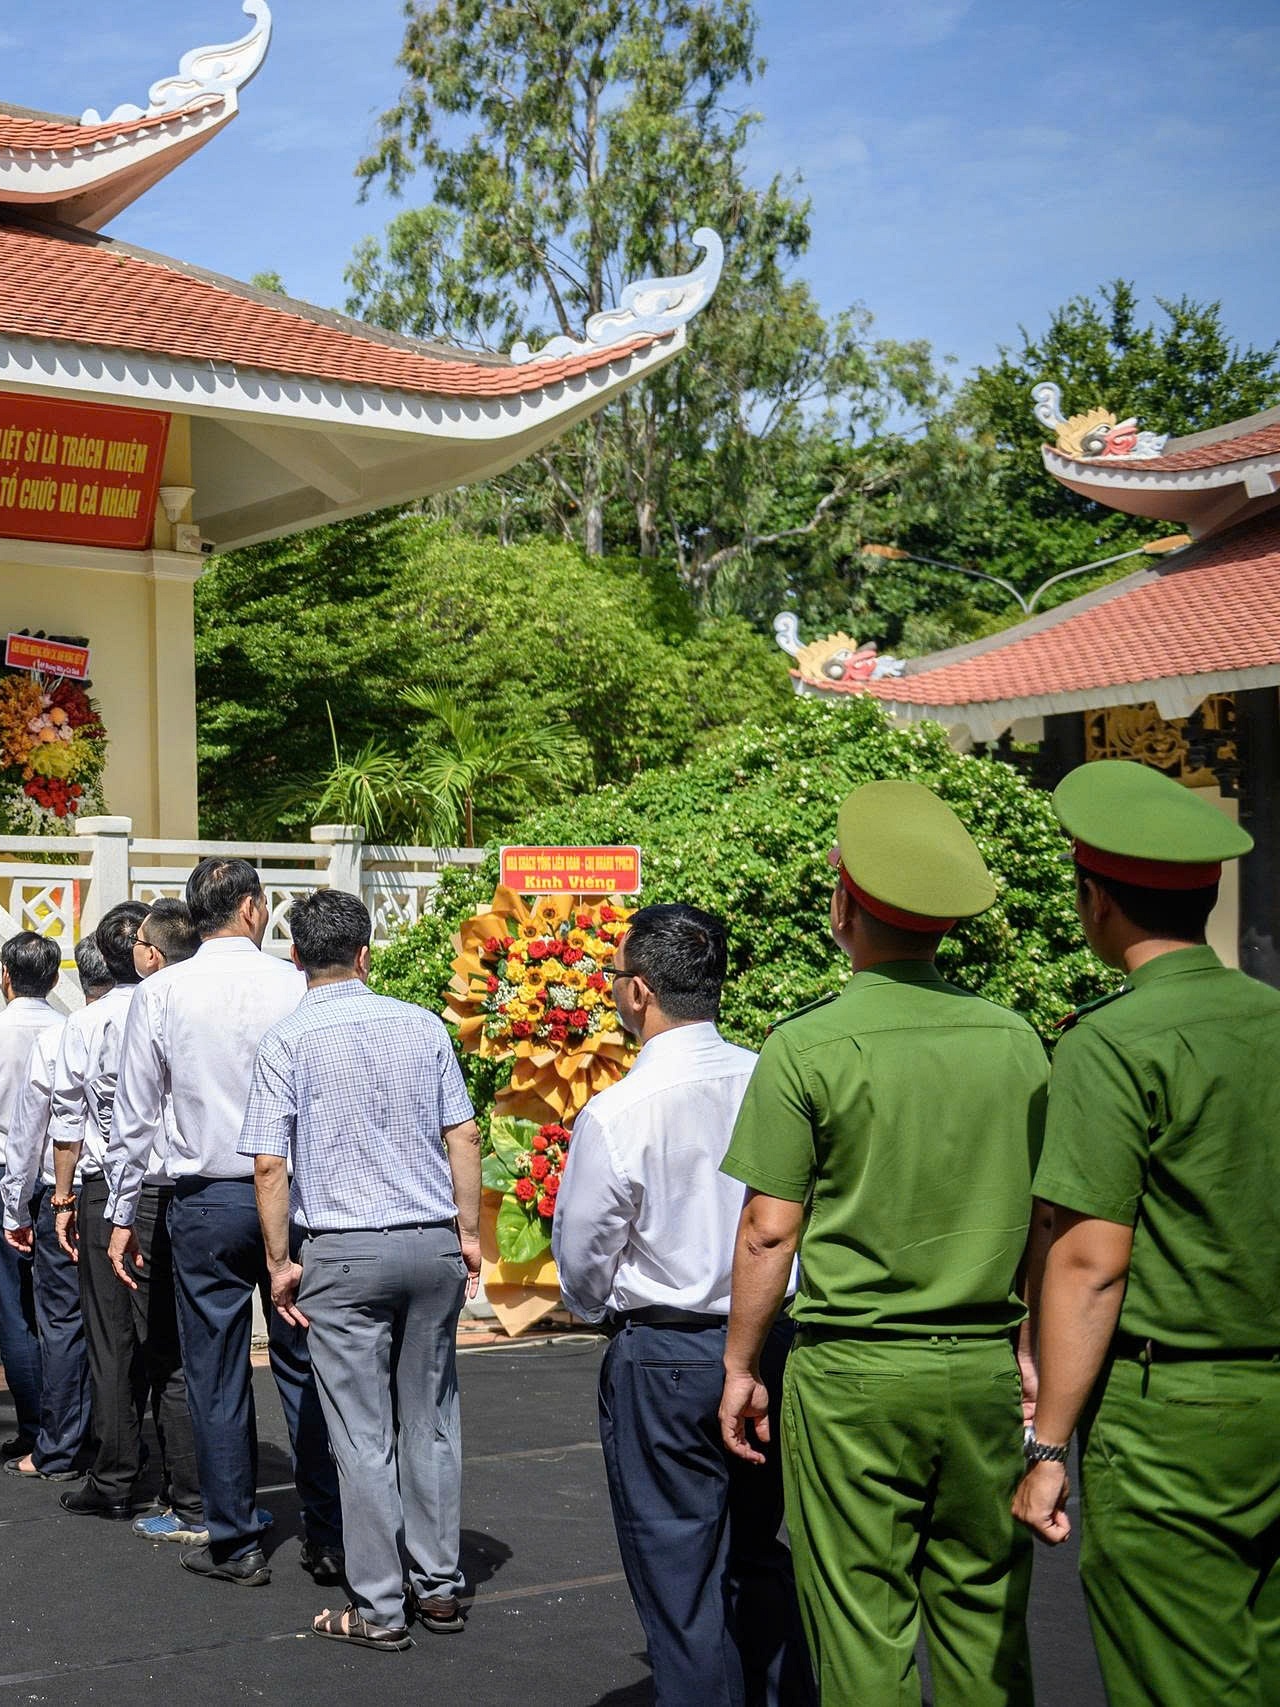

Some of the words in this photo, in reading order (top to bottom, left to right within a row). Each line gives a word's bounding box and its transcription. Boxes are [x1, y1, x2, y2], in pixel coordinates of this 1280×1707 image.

[24, 428, 42, 462] SĨ
[41, 429, 59, 465] LÀ
[60, 433, 105, 469] TRÁCH
[105, 438, 148, 478] NHIỆM
[18, 476, 58, 512] CHỨC
[59, 478, 78, 513] VÀ
[79, 481, 99, 516] CÁ
[99, 483, 142, 519] NHÂN!
[524, 875, 563, 889] Kính
[568, 875, 616, 891] Viếng
